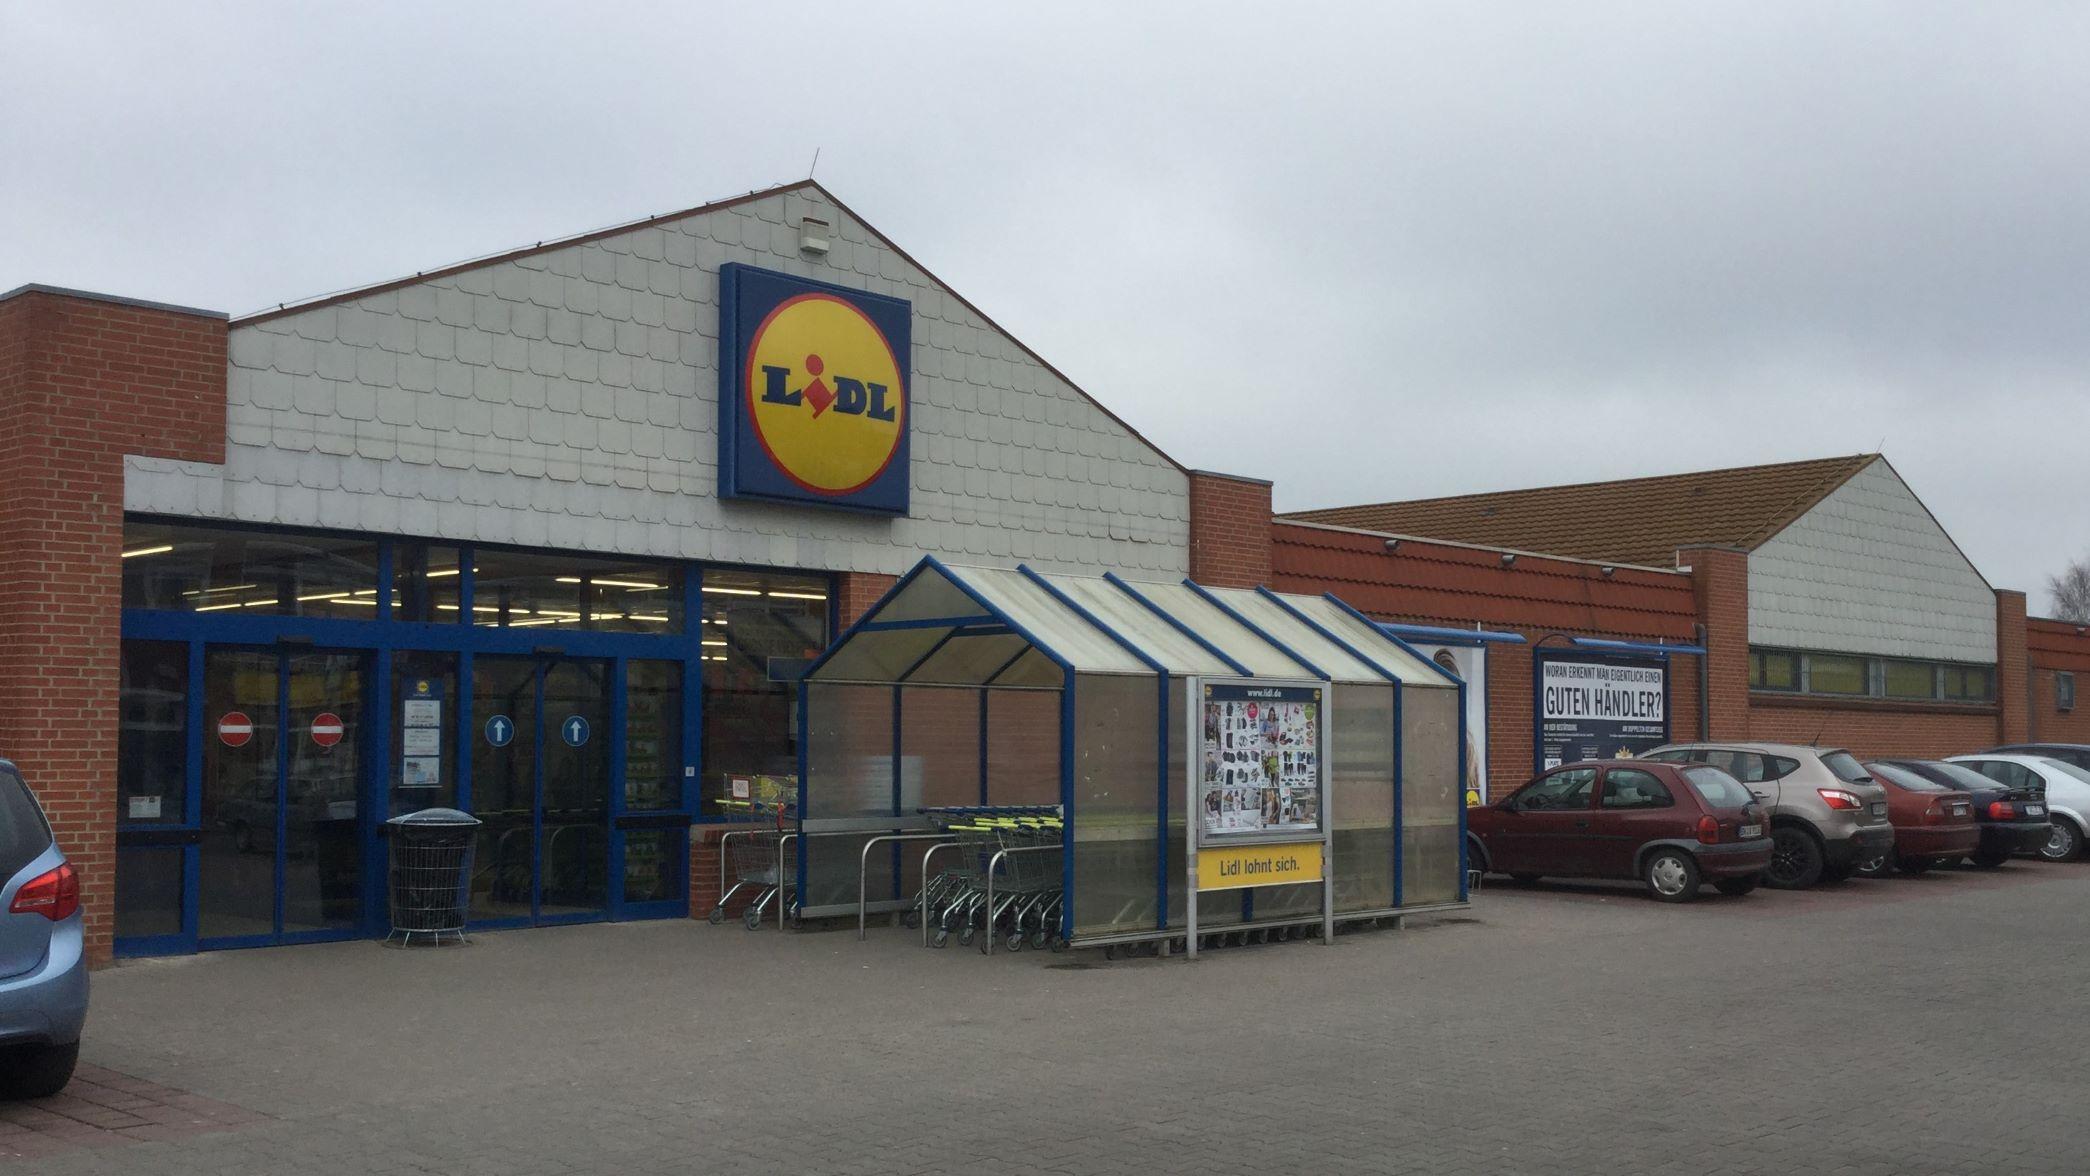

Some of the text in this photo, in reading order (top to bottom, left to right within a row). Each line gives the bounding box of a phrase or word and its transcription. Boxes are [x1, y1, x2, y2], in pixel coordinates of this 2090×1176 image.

[1545, 665, 1662, 684] WORAN ERKENNT MAN EIGENTLICH EINEN
[1247, 688, 1282, 698] www.lidl.de
[1546, 683, 1662, 718] GUTEN HÄNDLER?
[1220, 855, 1301, 876] Lidl lohnt sich.
